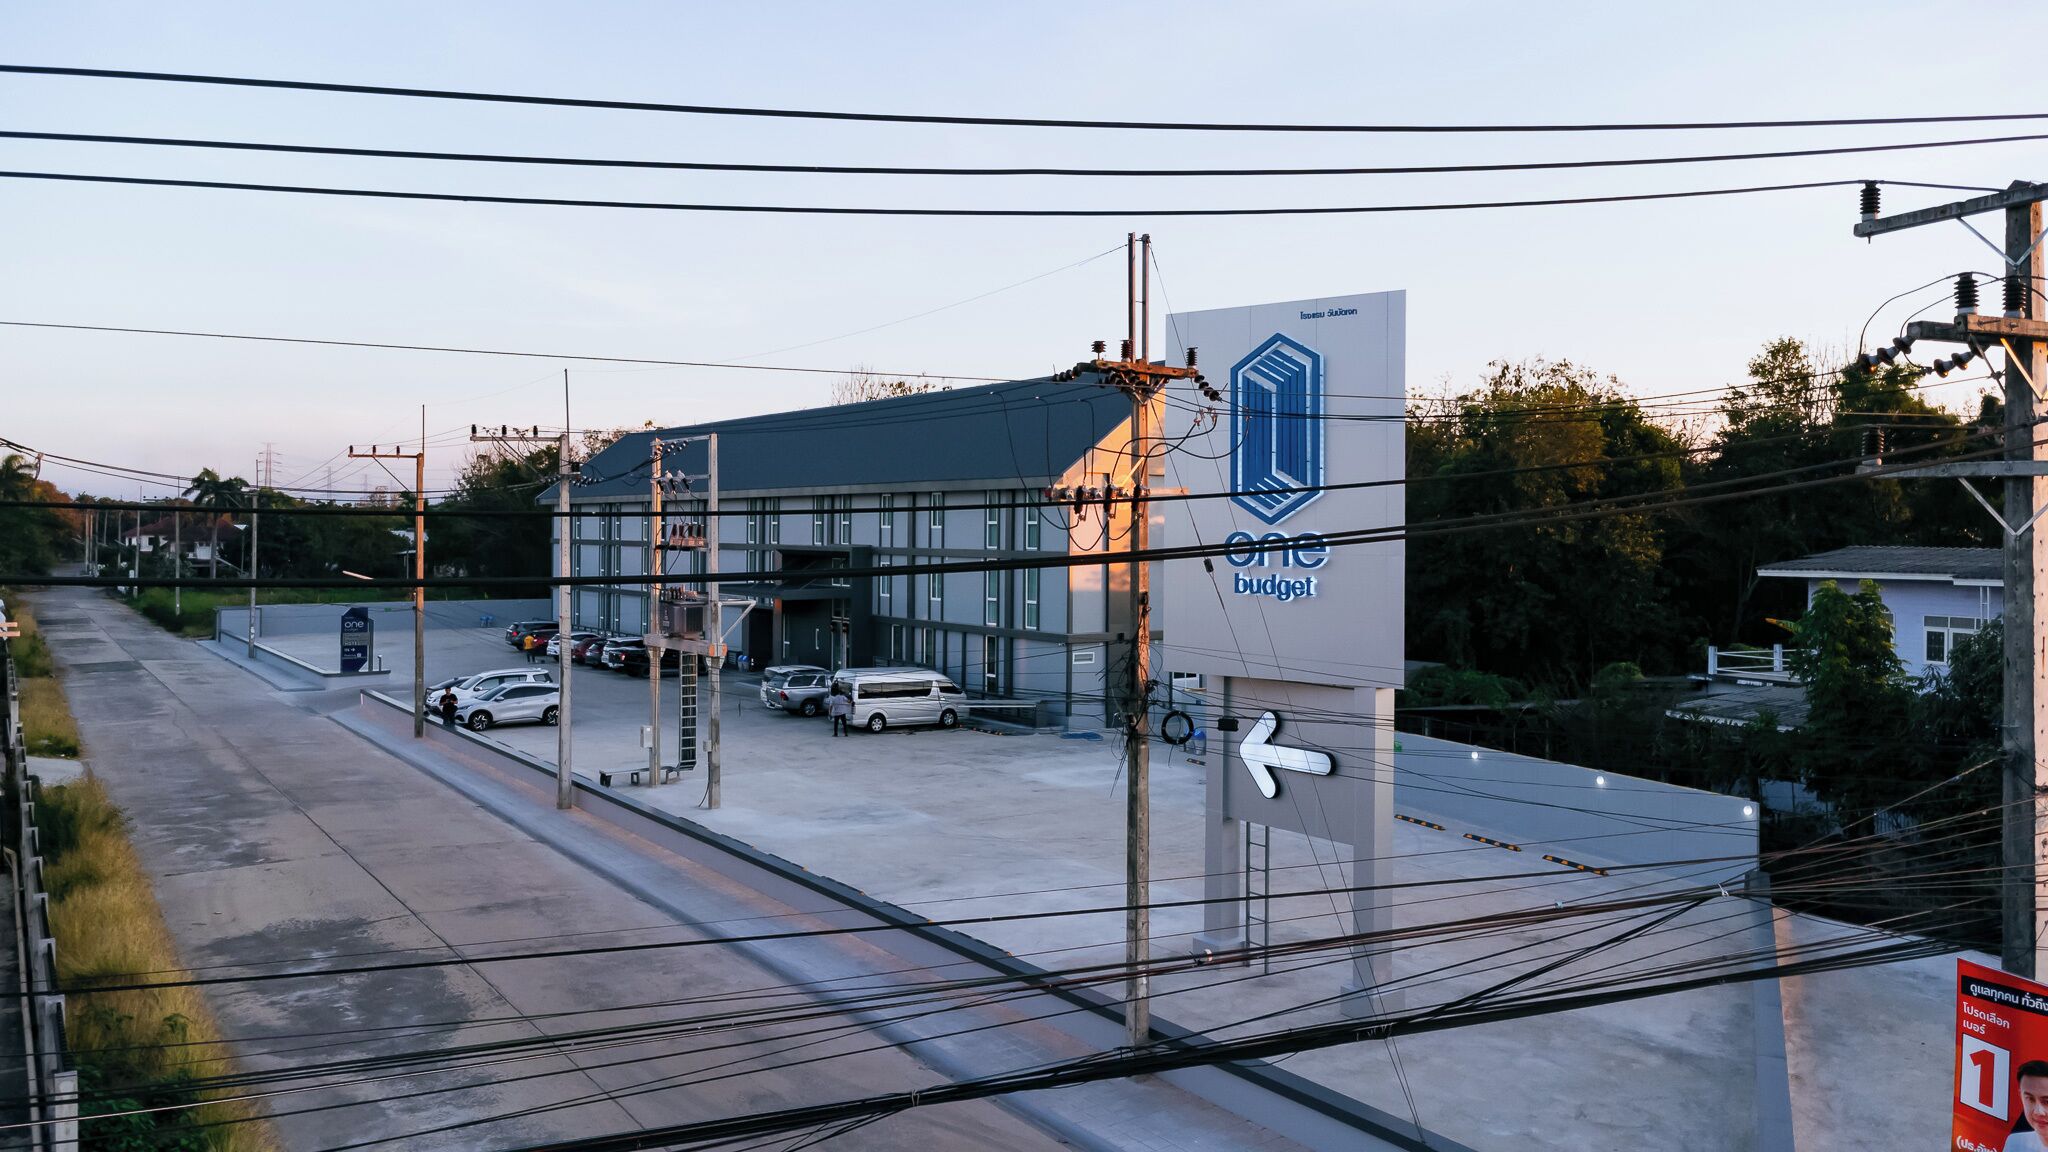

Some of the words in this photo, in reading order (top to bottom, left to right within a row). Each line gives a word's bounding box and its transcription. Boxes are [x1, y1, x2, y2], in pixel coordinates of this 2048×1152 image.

[1225, 531, 1331, 568] one
[1234, 573, 1315, 600] budget
[1970, 983, 2019, 1004] ดูแลทุกคน
[1963, 1002, 2010, 1029] โปรดเลือก
[1963, 1020, 1986, 1035] เบอร์
[1970, 1049, 1995, 1108] 1
